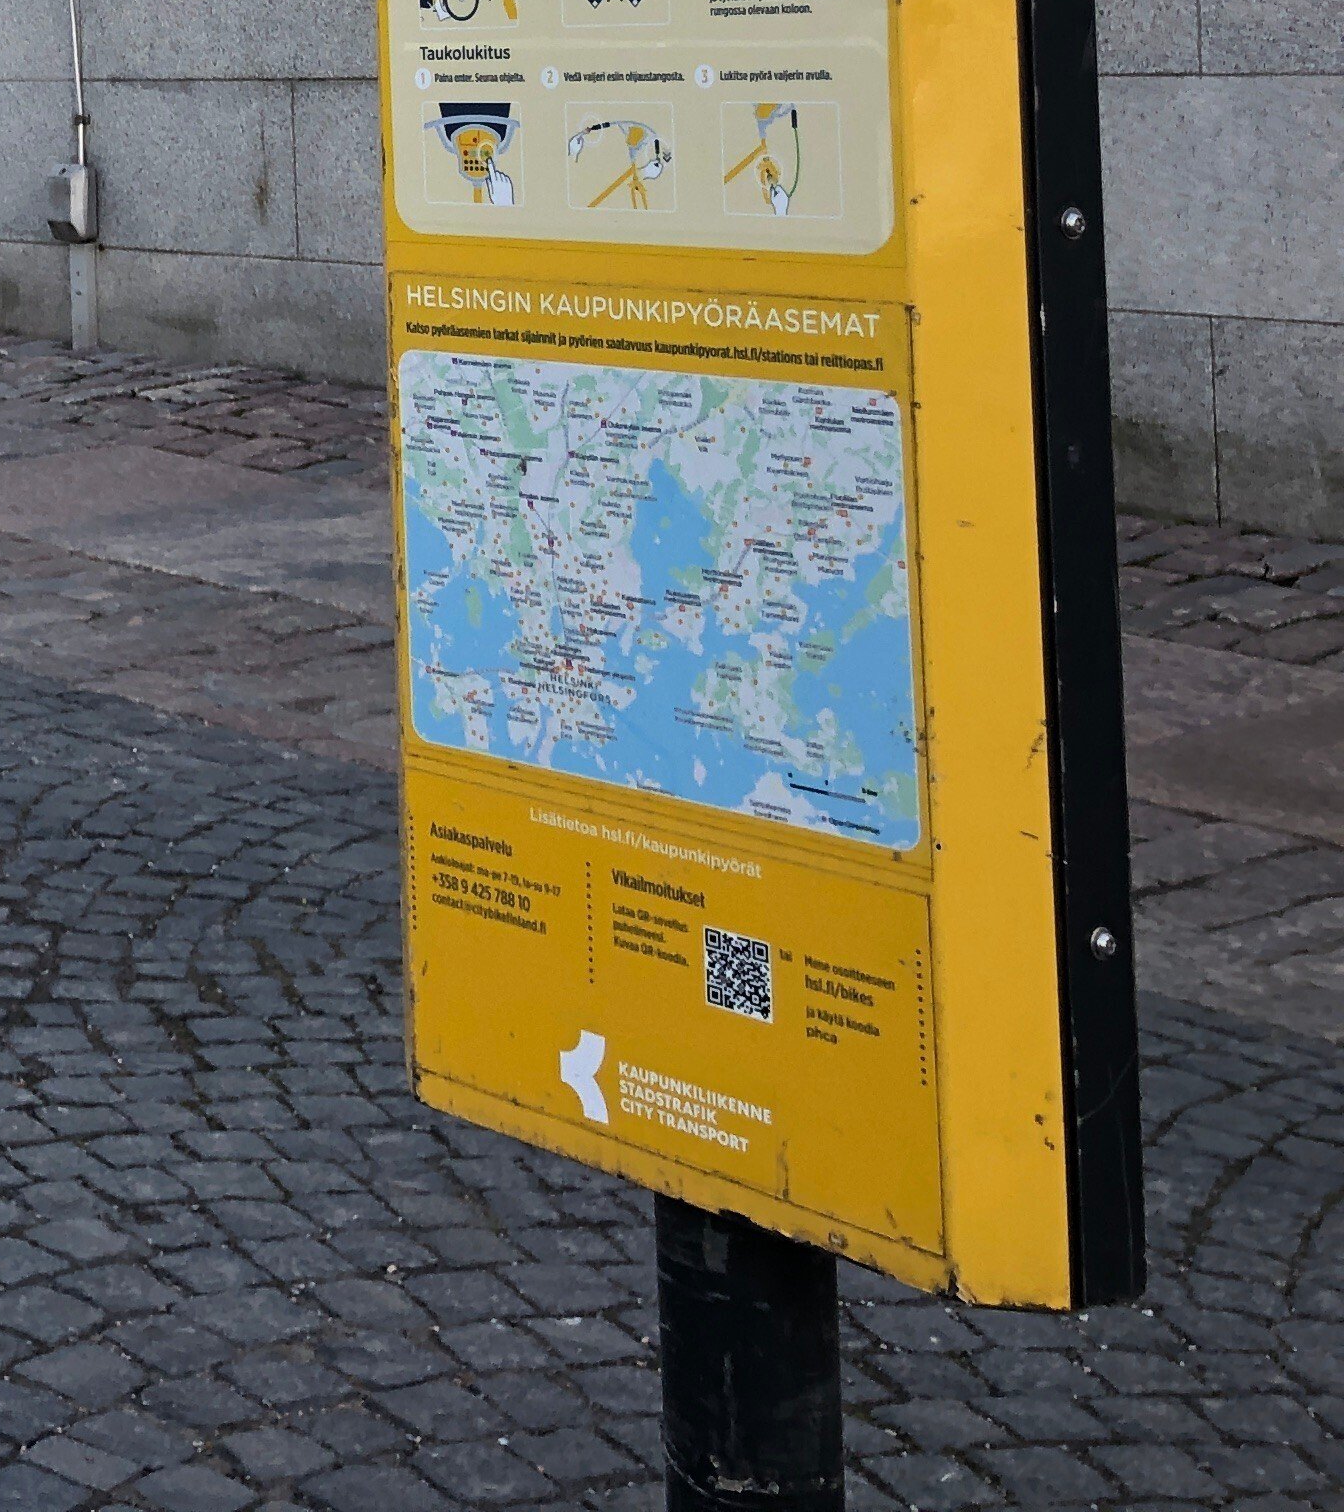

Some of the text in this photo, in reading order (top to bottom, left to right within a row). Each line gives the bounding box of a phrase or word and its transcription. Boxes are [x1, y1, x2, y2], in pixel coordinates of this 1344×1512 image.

[419, 45, 511, 61] Taukolukitus
[406, 285, 880, 338] HELSINGIN KAUPUNKIPYÖRÄASEMAT
[805, 353, 818, 366] tai
[430, 821, 512, 857] Asiakaspalvelu
[530, 807, 598, 836] Lisätietoa
[432, 872, 459, 891] +358
[612, 868, 705, 908] Vikailmoitukset
[618, 1061, 772, 1125] KAUPUNKILIIKENNE
[618, 1079, 718, 1125] STADSTRAFIK
[620, 1098, 749, 1152] CITY TRANSPORT
